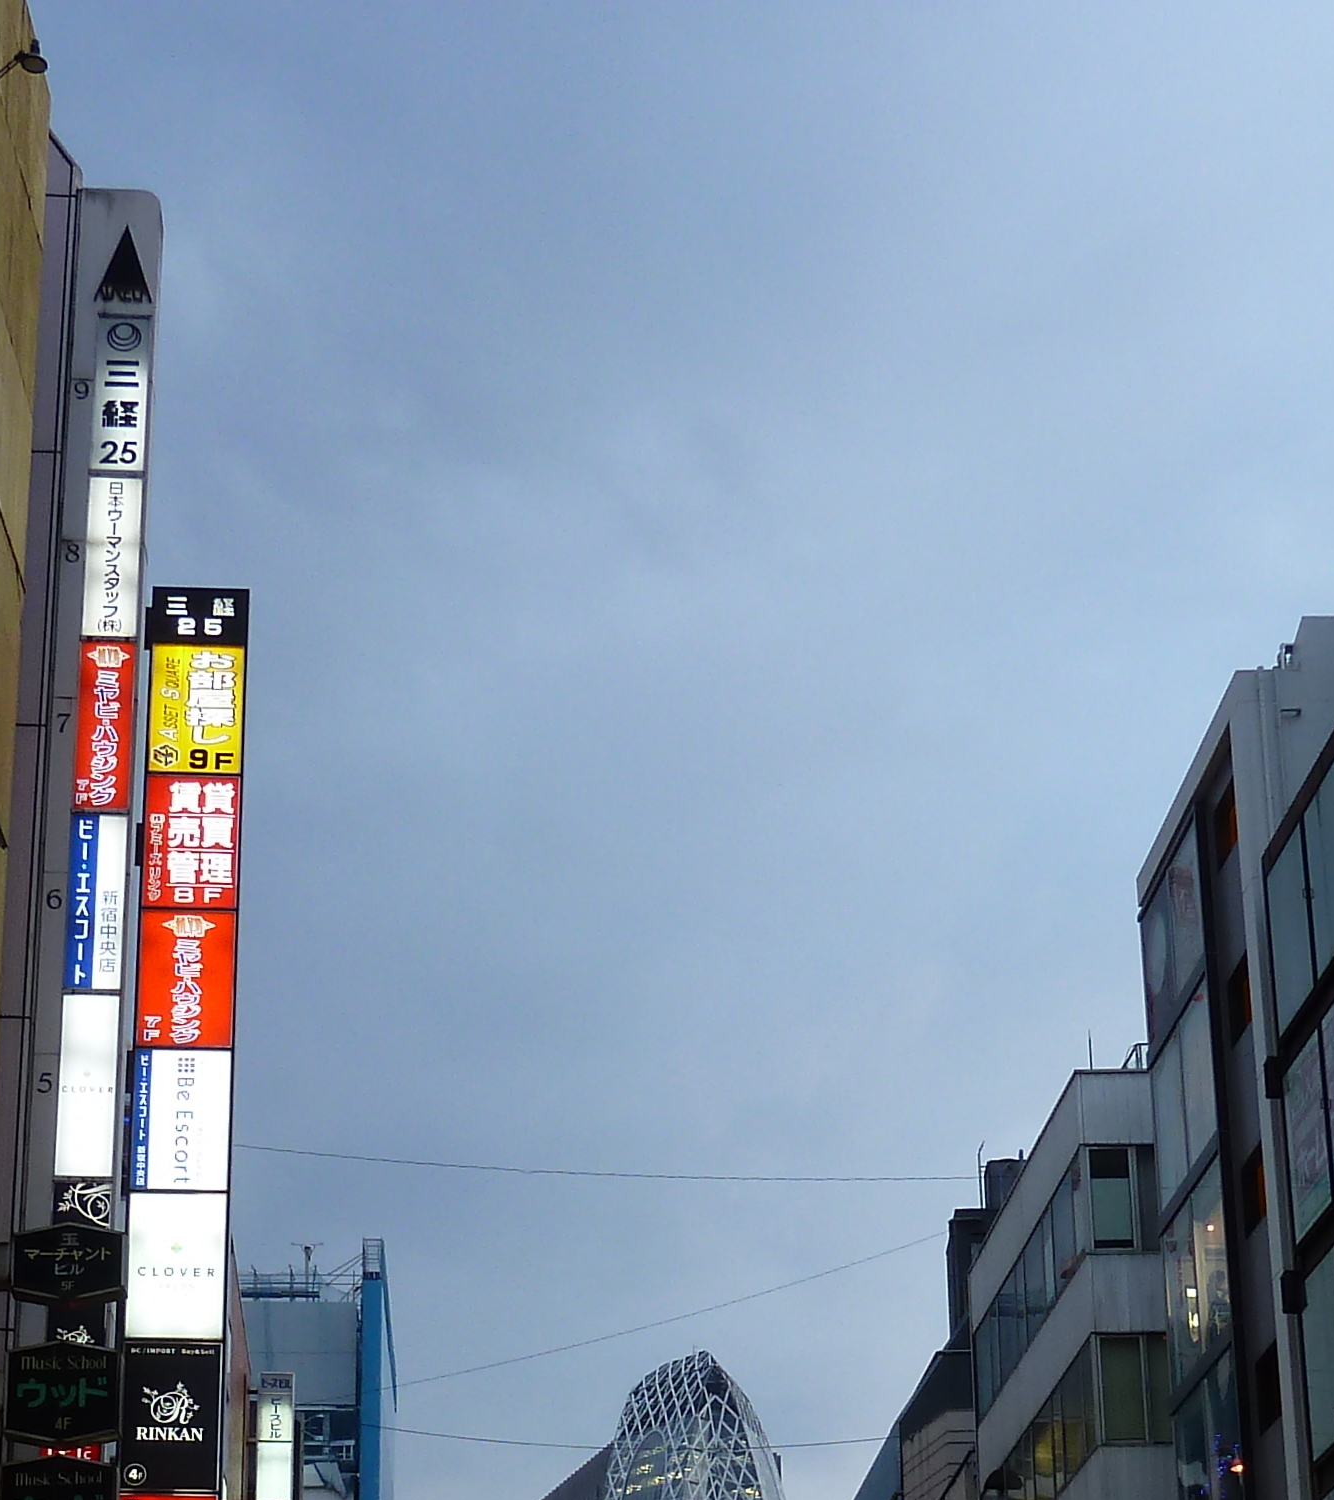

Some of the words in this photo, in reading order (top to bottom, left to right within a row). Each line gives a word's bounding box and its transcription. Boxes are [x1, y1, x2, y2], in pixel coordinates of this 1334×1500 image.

[74, 381, 90, 400] 9
[100, 359, 141, 429] 三経
[99, 440, 138, 466] 25
[64, 542, 81, 566] 8
[177, 618, 223, 636] 25
[56, 713, 72, 733] 7
[189, 749, 234, 770] 9F
[168, 816, 235, 848] 売買
[167, 851, 233, 884] 管理
[46, 888, 63, 910] 6
[73, 818, 94, 985] ビー・エスコート
[98, 890, 119, 974] 新宿中央店
[36, 1072, 53, 1093] 5
[62, 1085, 114, 1095] CLOVER
[176, 1077, 195, 1101] Be
[173, 1110, 195, 1184] Escort
[23, 1247, 112, 1262] マーチャント
[138, 1266, 216, 1278] CLOVER
[21, 1355, 61, 1370] Music
[67, 1354, 107, 1370] School
[16, 1376, 108, 1408] ウッド
[54, 1416, 72, 1430] 4F
[136, 1426, 204, 1442] RINKAN
